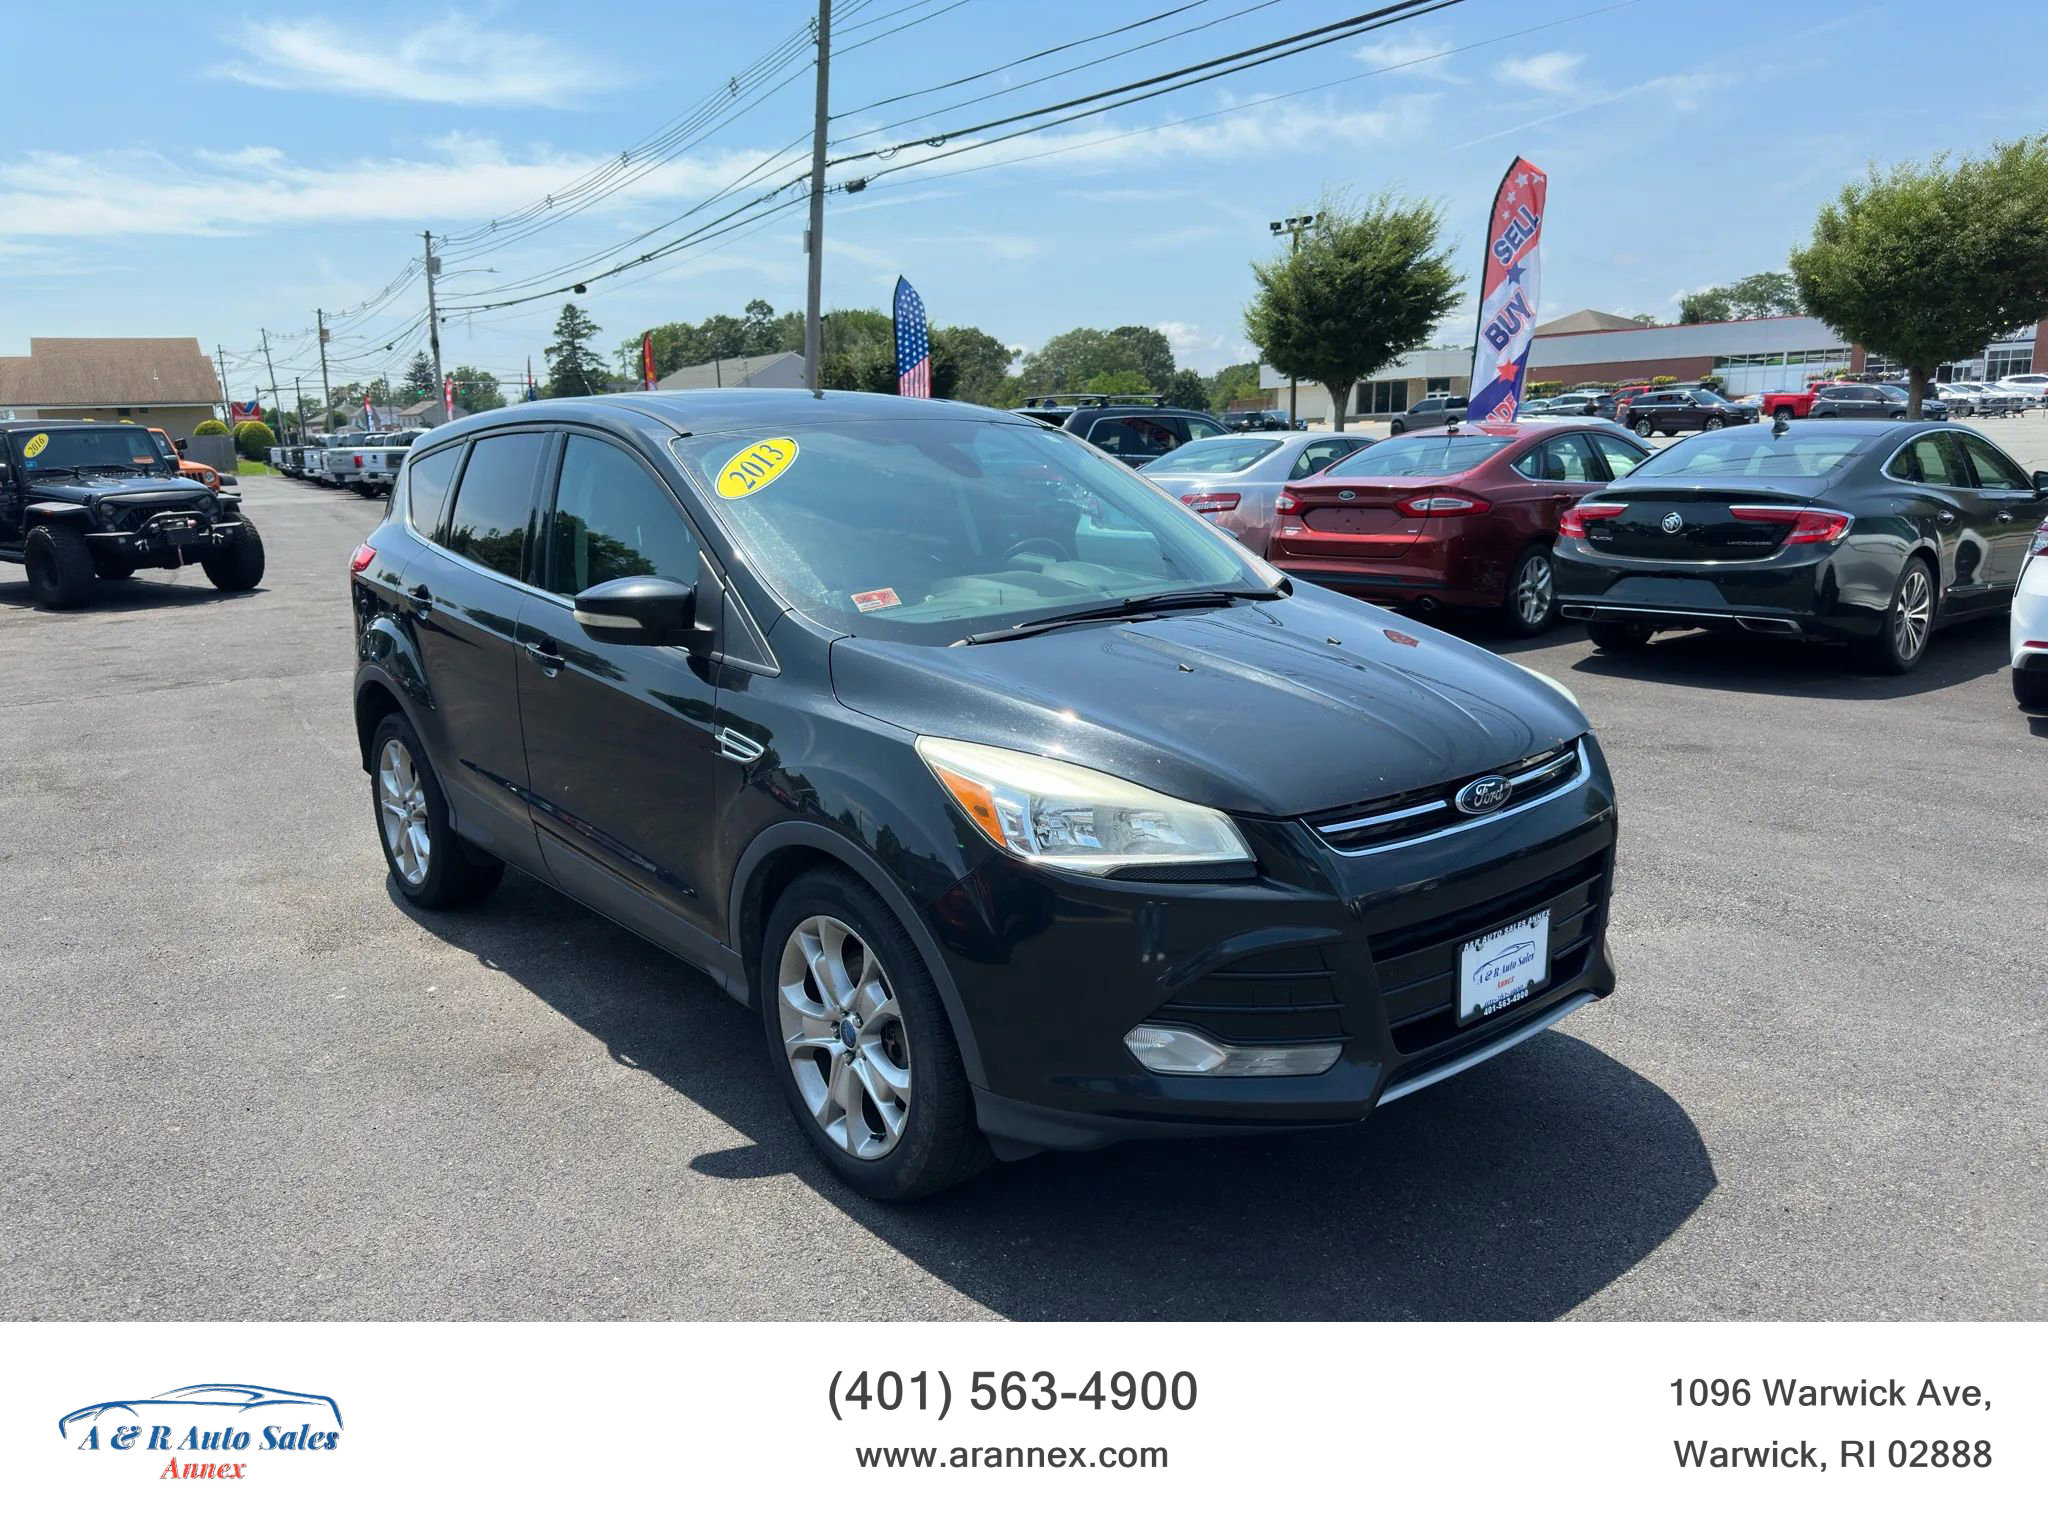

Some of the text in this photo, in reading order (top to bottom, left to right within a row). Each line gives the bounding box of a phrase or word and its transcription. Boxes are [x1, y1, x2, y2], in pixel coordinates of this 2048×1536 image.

[1493, 206, 1540, 266] SELL
[1482, 288, 1535, 353] BUY
[28, 436, 45, 455] 2016
[730, 445, 783, 489] 2013
[1474, 782, 1503, 807] Ford
[1482, 930, 1502, 943] AUTO
[1504, 919, 1526, 935] SALES
[1528, 908, 1551, 924] ANNEX
[1518, 952, 1535, 967] Sales
[1483, 989, 1529, 1016] 401-563-4900
